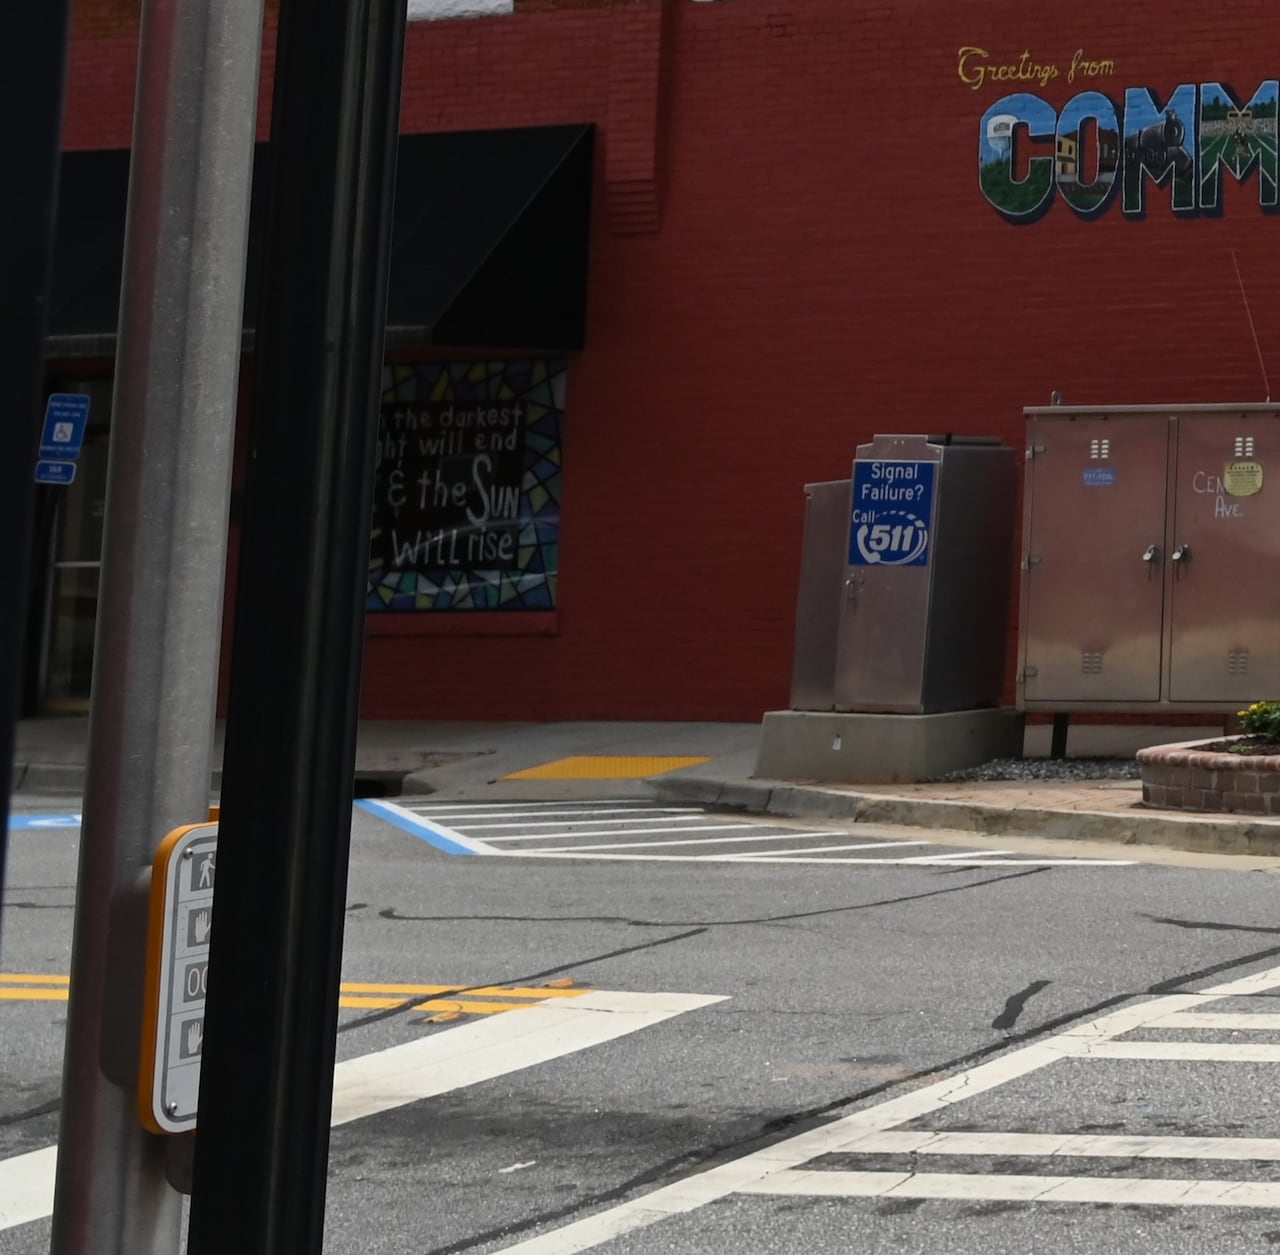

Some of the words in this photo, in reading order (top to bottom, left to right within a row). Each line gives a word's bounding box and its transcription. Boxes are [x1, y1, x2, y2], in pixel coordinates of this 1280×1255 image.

[958, 46, 1059, 90] Greetings
[1067, 48, 1116, 85] from
[394, 407, 433, 430] the
[440, 402, 523, 428] darkest
[419, 429, 463, 455] will
[475, 428, 517, 450] end
[871, 462, 918, 484] Signal
[1193, 470, 1225, 494] CEN
[417, 469, 467, 511] the
[861, 484, 924, 501] Failure?
[852, 509, 875, 523] Call
[467, 526, 513, 561] rise
[869, 524, 914, 551] 511
